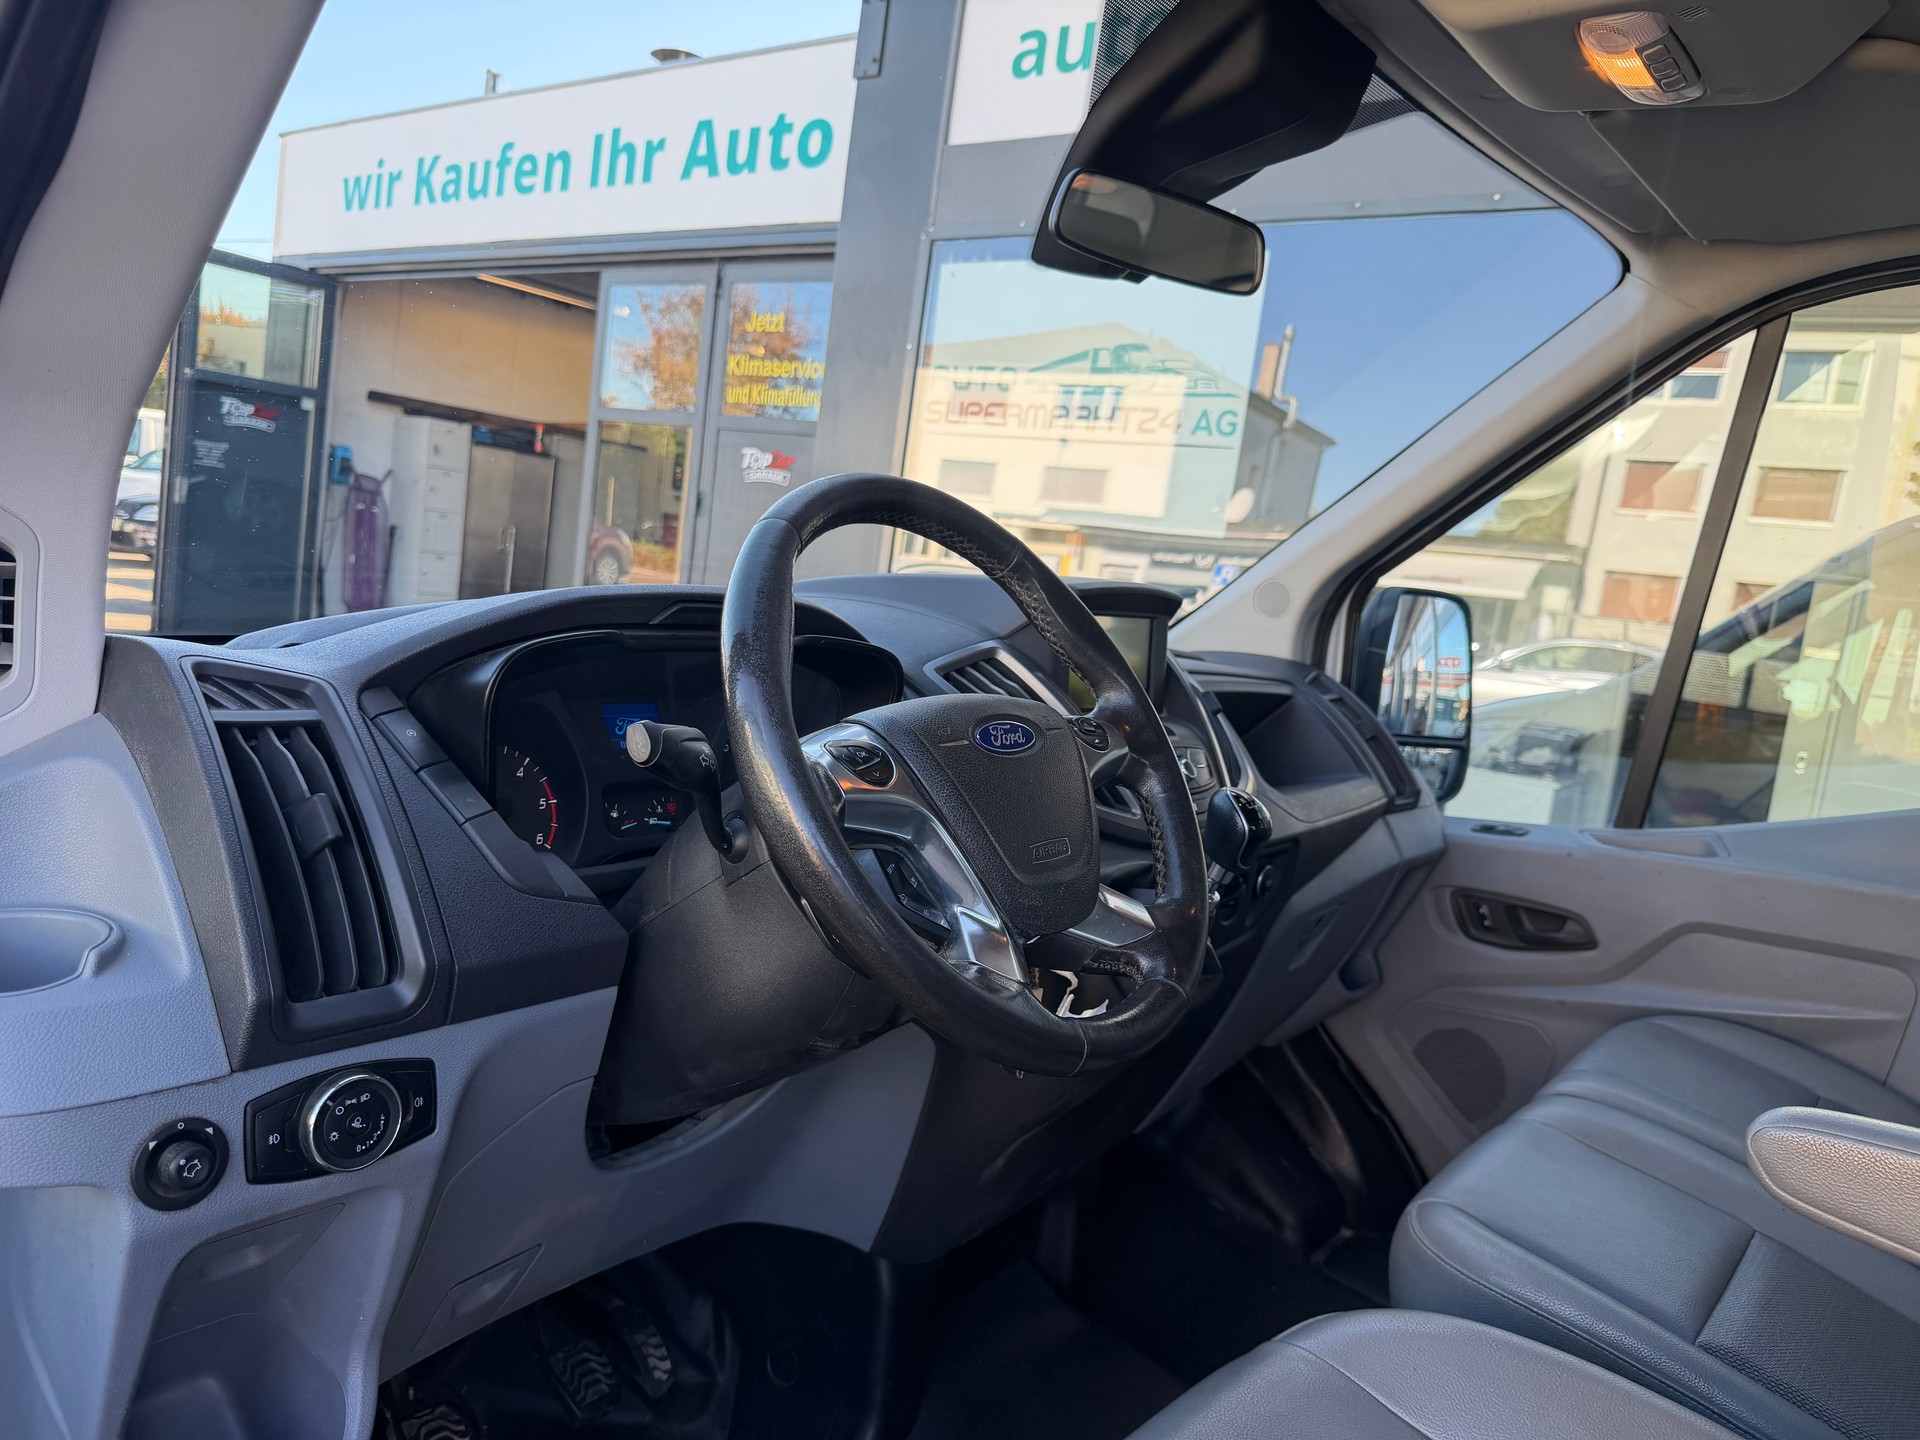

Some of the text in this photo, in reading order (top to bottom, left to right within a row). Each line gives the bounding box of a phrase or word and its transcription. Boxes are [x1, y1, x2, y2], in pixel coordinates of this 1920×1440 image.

[343, 112, 833, 212] wir Kaufen Ihr Auto
[744, 310, 785, 332] Jetzt
[727, 382, 750, 404] und
[1190, 409, 1239, 437] AG
[989, 724, 1026, 746] Ford
[516, 766, 524, 779] 4
[538, 797, 547, 810] 5
[536, 832, 544, 846] 6
